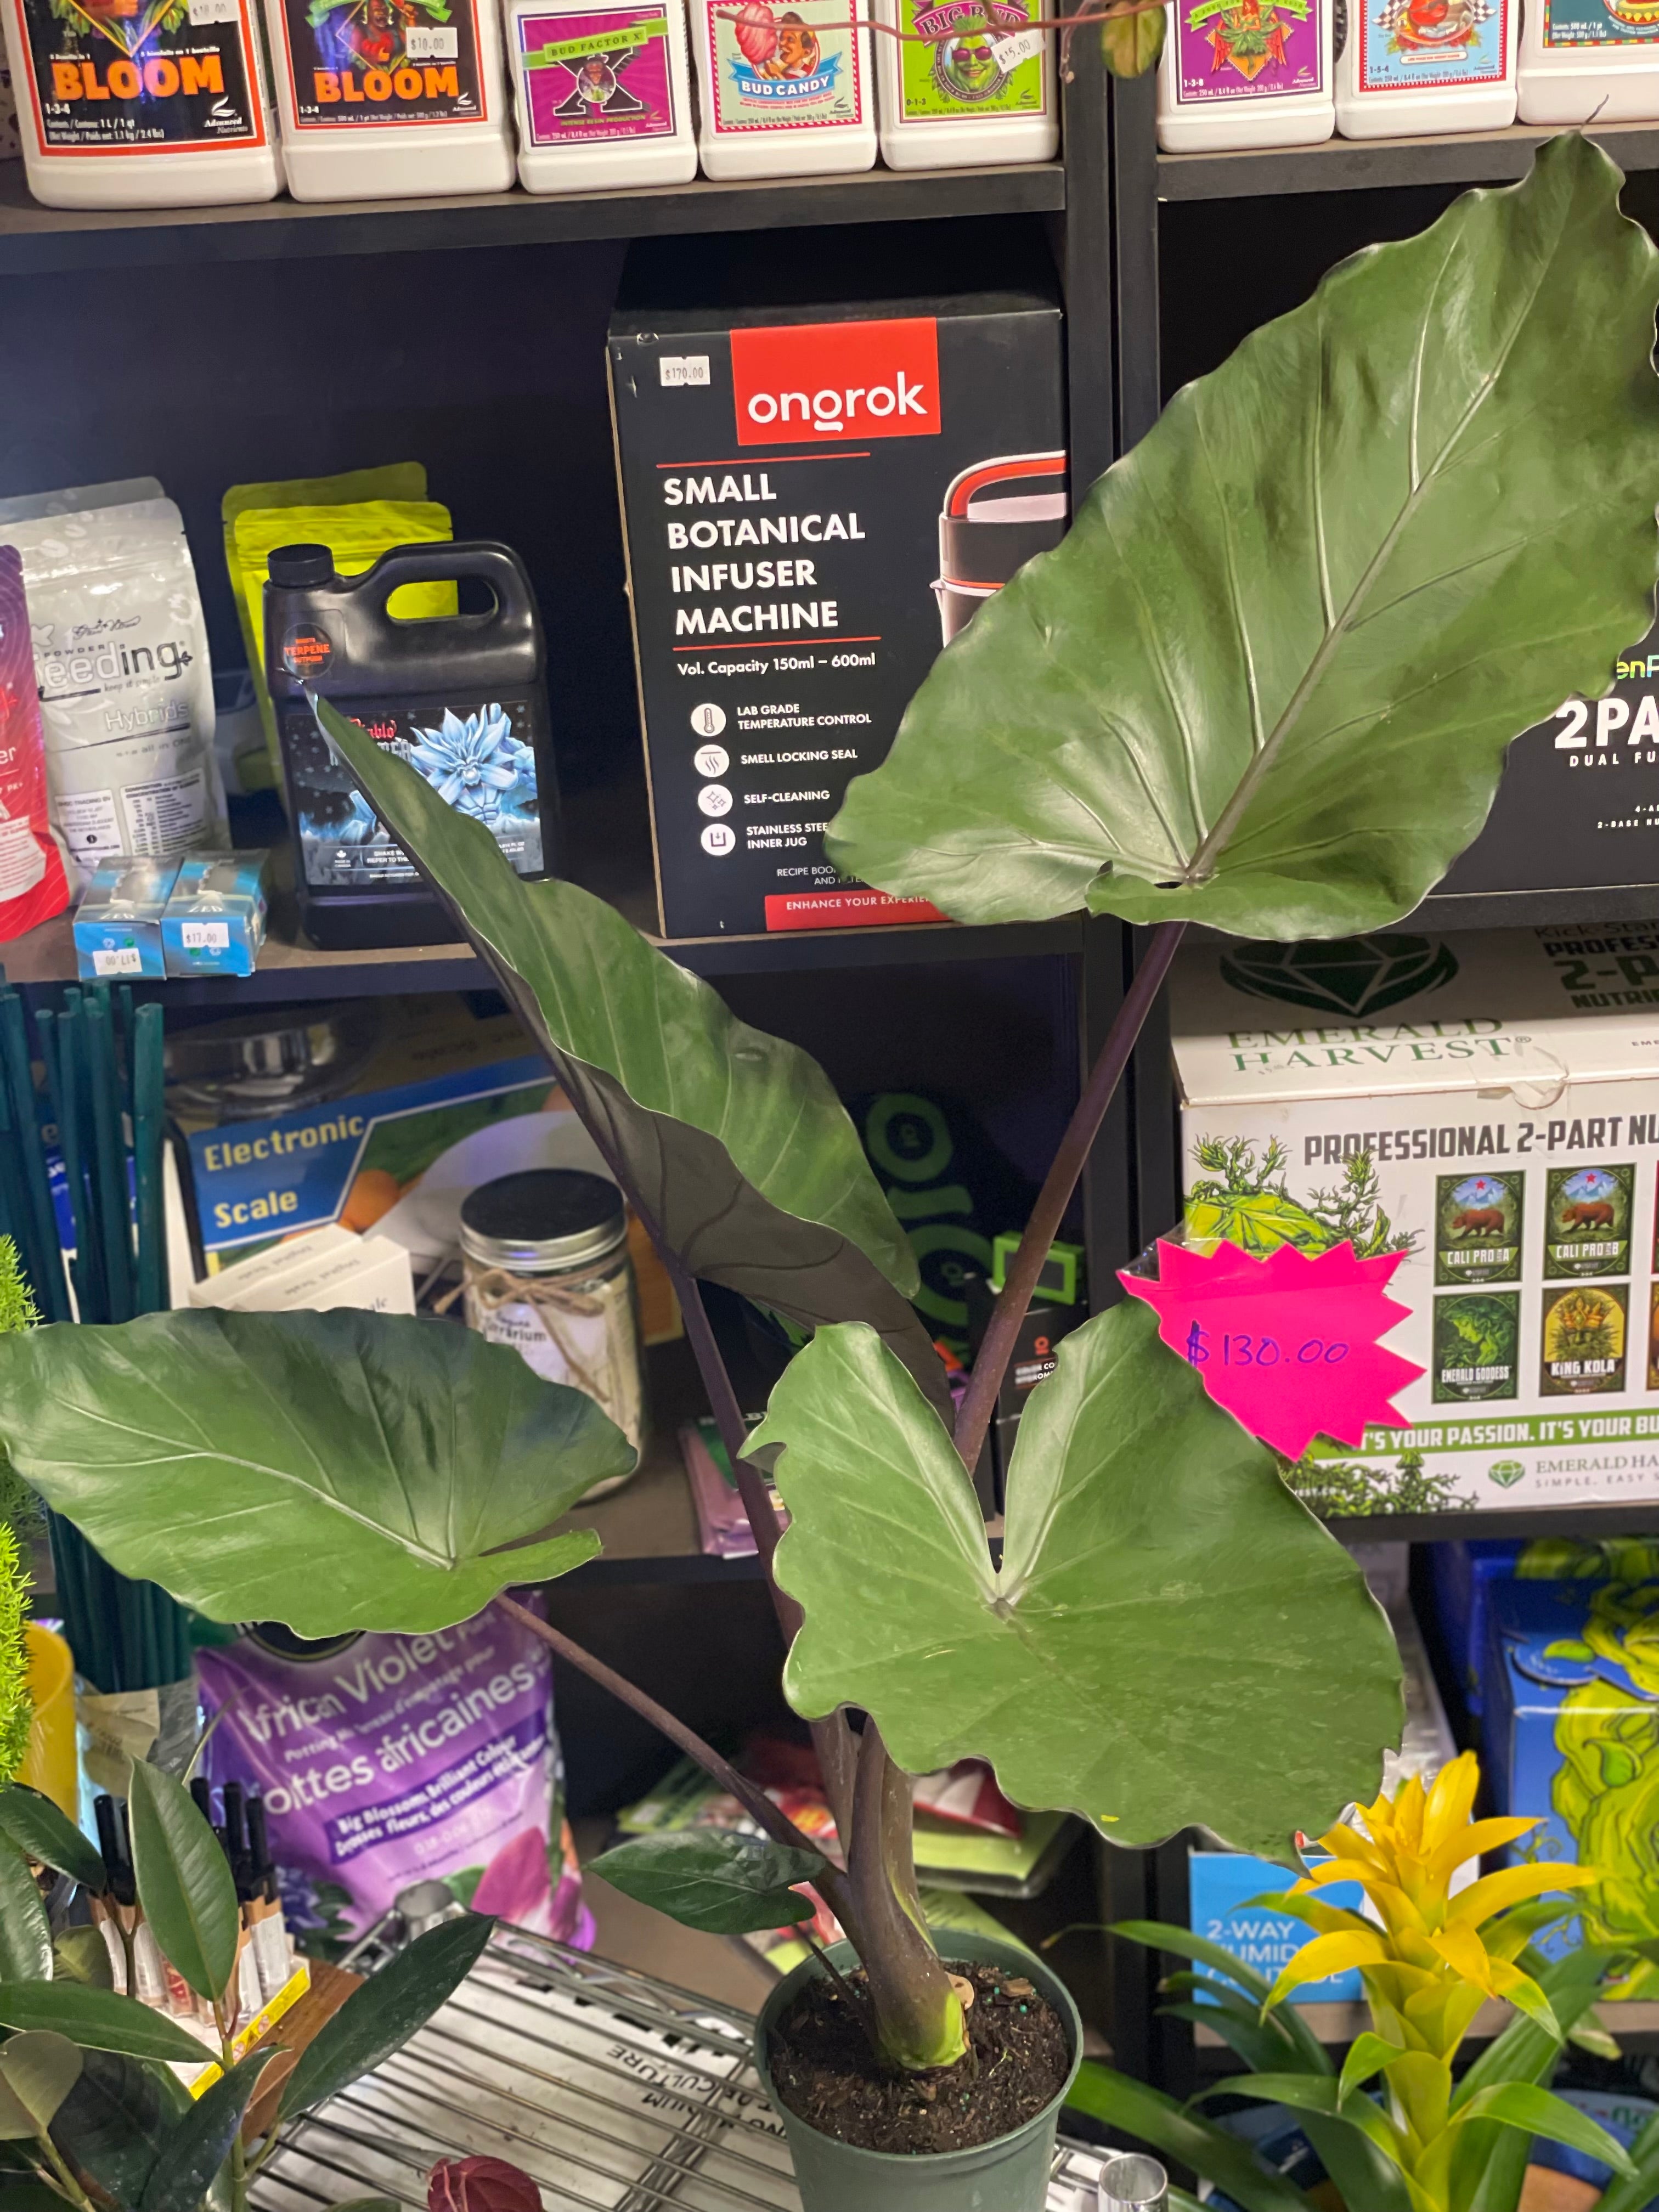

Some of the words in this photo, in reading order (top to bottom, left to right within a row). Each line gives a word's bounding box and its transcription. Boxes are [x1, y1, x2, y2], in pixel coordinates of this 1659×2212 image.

[920, 6, 965, 36] BIG
[410, 37, 445, 51] $10.00
[551, 46, 575, 57] BUD
[580, 35, 629, 52] FACTOR
[634, 32, 642, 41] X
[51, 54, 224, 100] BLOOM
[313, 66, 459, 103] BLOOM
[742, 81, 772, 95] BUD
[776, 76, 830, 95] CANDY
[1184, 78, 1204, 87] 1-3-8
[204, 117, 242, 127] Advanced
[665, 366, 703, 380] $170.00
[748, 371, 928, 432] ongrok
[663, 473, 777, 506] SMALL
[667, 513, 866, 549] BOTANICAL
[672, 560, 817, 592] INFUSER
[675, 601, 838, 635] MACHINE
[44, 644, 105, 658] POWDER
[284, 644, 330, 656] TERPENE
[35, 640, 183, 690] eeding
[677, 662, 705, 675] Vol.
[708, 659, 769, 676] Capacity
[773, 656, 815, 670] 150ml
[831, 652, 876, 667] 600ml
[105, 700, 189, 731] Hybrids
[737, 706, 758, 716] LAB
[760, 703, 800, 714] GRADE
[738, 716, 815, 730] TEMPERATURE
[817, 714, 872, 726] CONTROL
[741, 754, 775, 765] SMELL
[777, 751, 829, 763] LOCKING
[831, 749, 858, 760] SEAL
[1570, 753, 1620, 767] DUAL
[1634, 751, 1656, 764] FU
[744, 791, 831, 804] SELF-CLEANING
[746, 824, 803, 836] STAINLESS
[805, 822, 831, 833] STEE
[1598, 820, 1639, 829] 2-BASE
[747, 838, 783, 849] INNER
[785, 837, 808, 848] JUG
[777, 866, 809, 877] RECIPE
[811, 865, 836, 875] BOO
[814, 877, 836, 885] AND
[786, 898, 842, 911] ENHANCE
[845, 896, 878, 907] YOUR
[186, 932, 217, 943] $17.00
[105, 953, 137, 966] $17.00
[1227, 1018, 1503, 1049] EMERALD
[204, 1114, 367, 1173] Electronic
[1304, 1124, 1510, 1166] PROFESSIONAL
[1516, 1116, 1623, 1154] 2-PART
[1628, 1114, 1659, 1147] NU
[214, 1189, 298, 1229] Scale
[1447, 1251, 1470, 1265] CALI
[1473, 1249, 1494, 1263] PRO
[1503, 1249, 1510, 1262] A
[1556, 1245, 1579, 1259] CALI
[1582, 1243, 1603, 1257] PRO
[1611, 1242, 1619, 1255] B
[1441, 1368, 1474, 1383] EMERALD
[1476, 1365, 1510, 1380] GODDESS
[1584, 1359, 1615, 1373] KOLA
[1390, 1427, 1443, 1449] YOUR
[1447, 1422, 1535, 1446] PASSION.
[1539, 1419, 1574, 1441] IT'S
[1578, 1417, 1631, 1437] YOUR
[1536, 1454, 1628, 1474] EMERALD
[1632, 1454, 1659, 1468] HA
[1606, 1473, 1644, 1484] EASY
[333, 1630, 455, 1704] Violet
[375, 1661, 537, 1774] africaines
[337, 1814, 364, 1835] Big
[425, 1759, 478, 1799] Brilliant
[1207, 1919, 1295, 1940] 2-WAY
[606, 2044, 717, 2094] CULTURE
